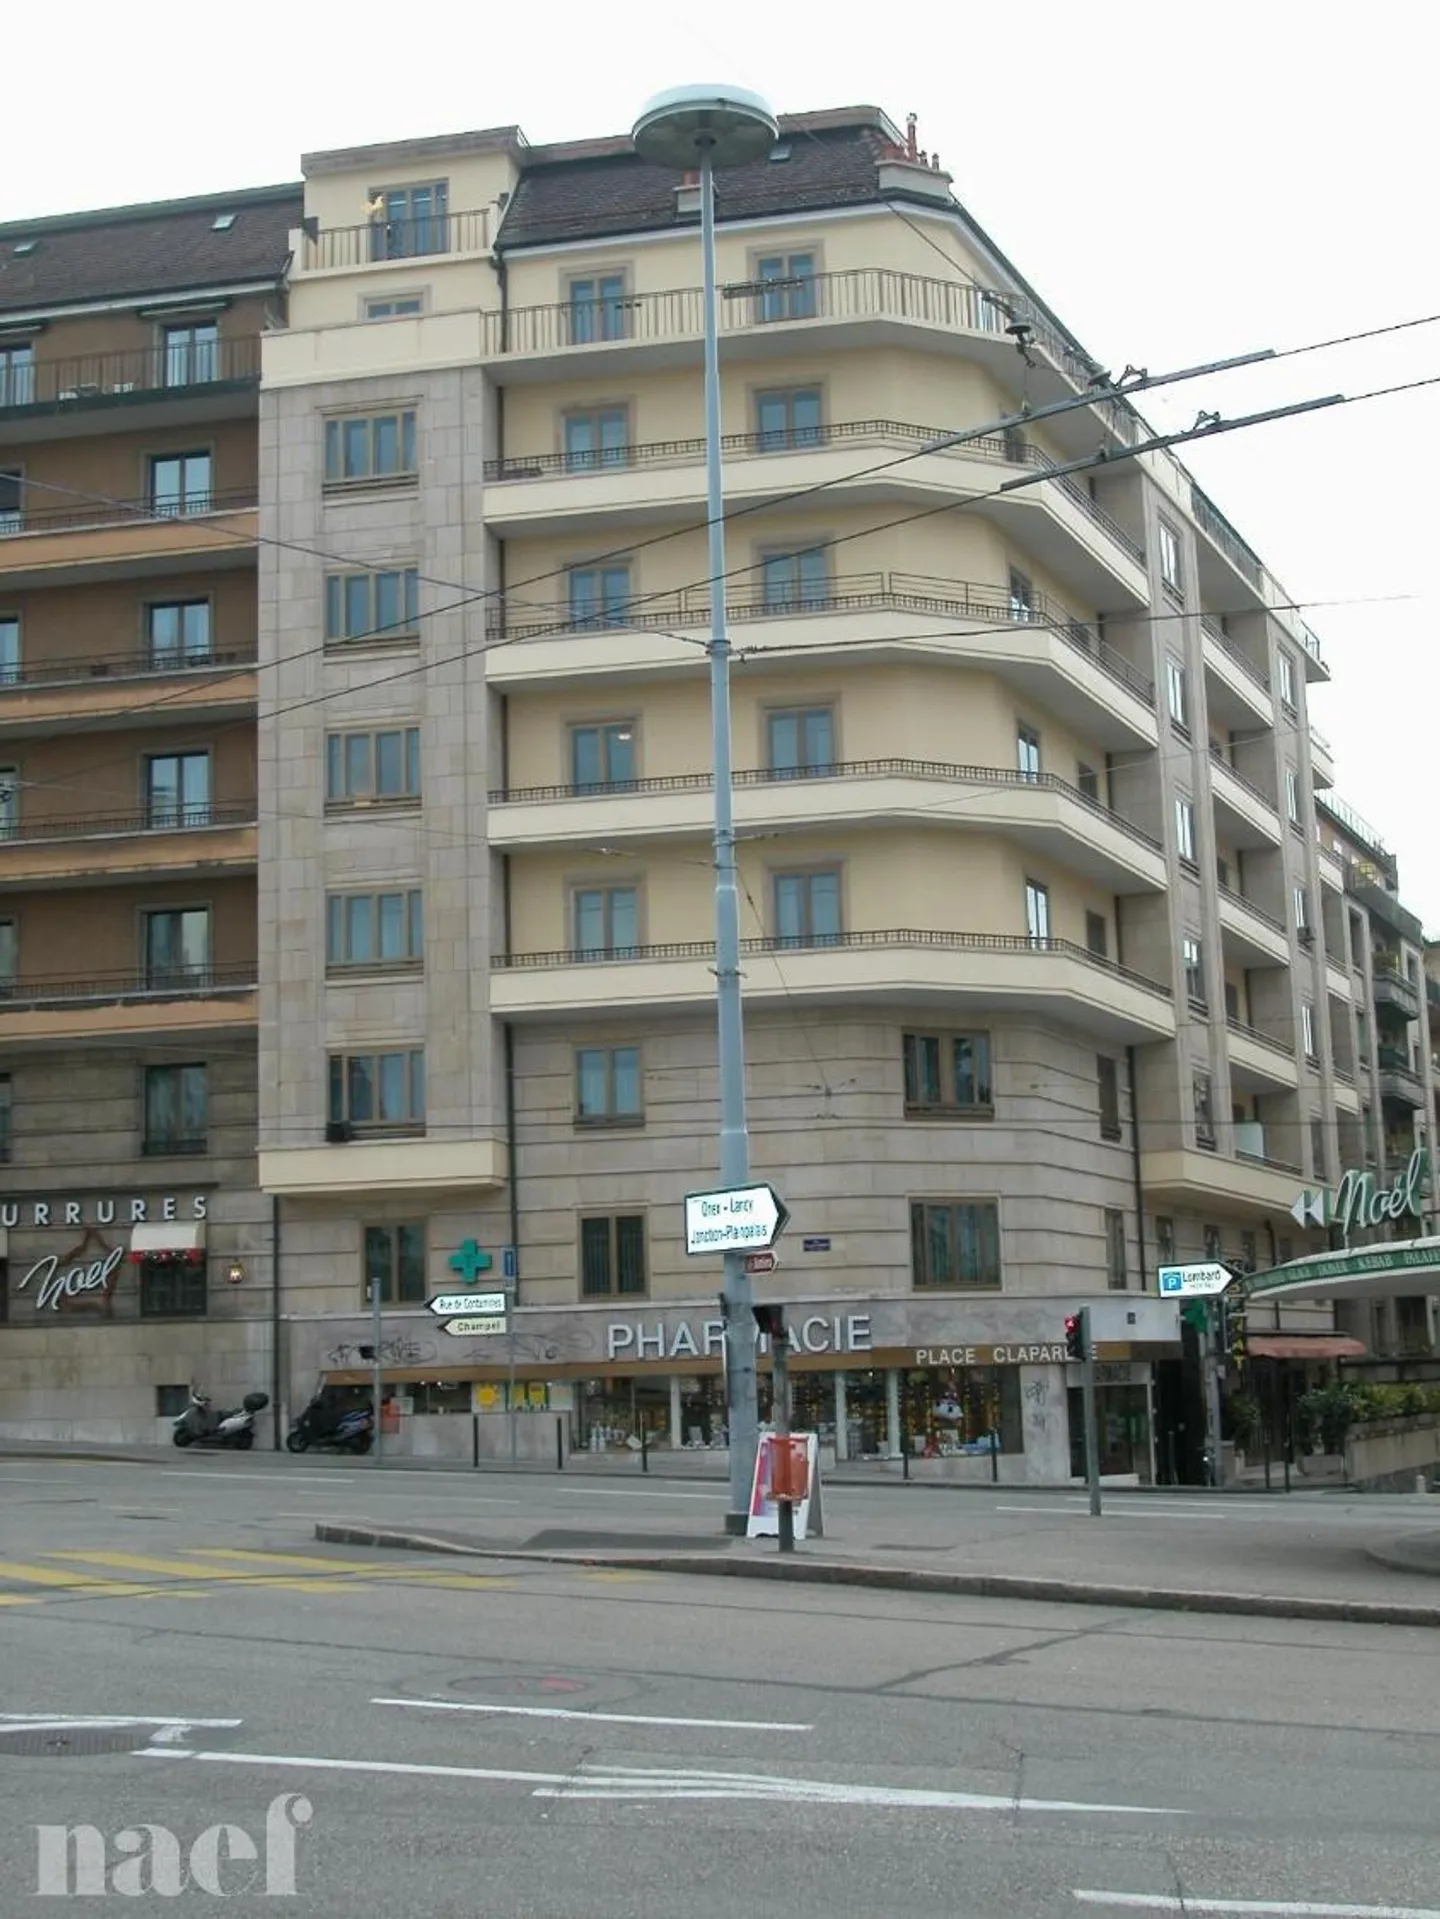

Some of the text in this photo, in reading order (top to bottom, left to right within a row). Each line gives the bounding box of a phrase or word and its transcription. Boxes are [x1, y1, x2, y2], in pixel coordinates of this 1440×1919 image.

[1, 1197, 206, 1227] URRURES
[1183, 1269, 1221, 1282] Lombard
[456, 1320, 501, 1332] Champel
[915, 1347, 976, 1365] PLACE
